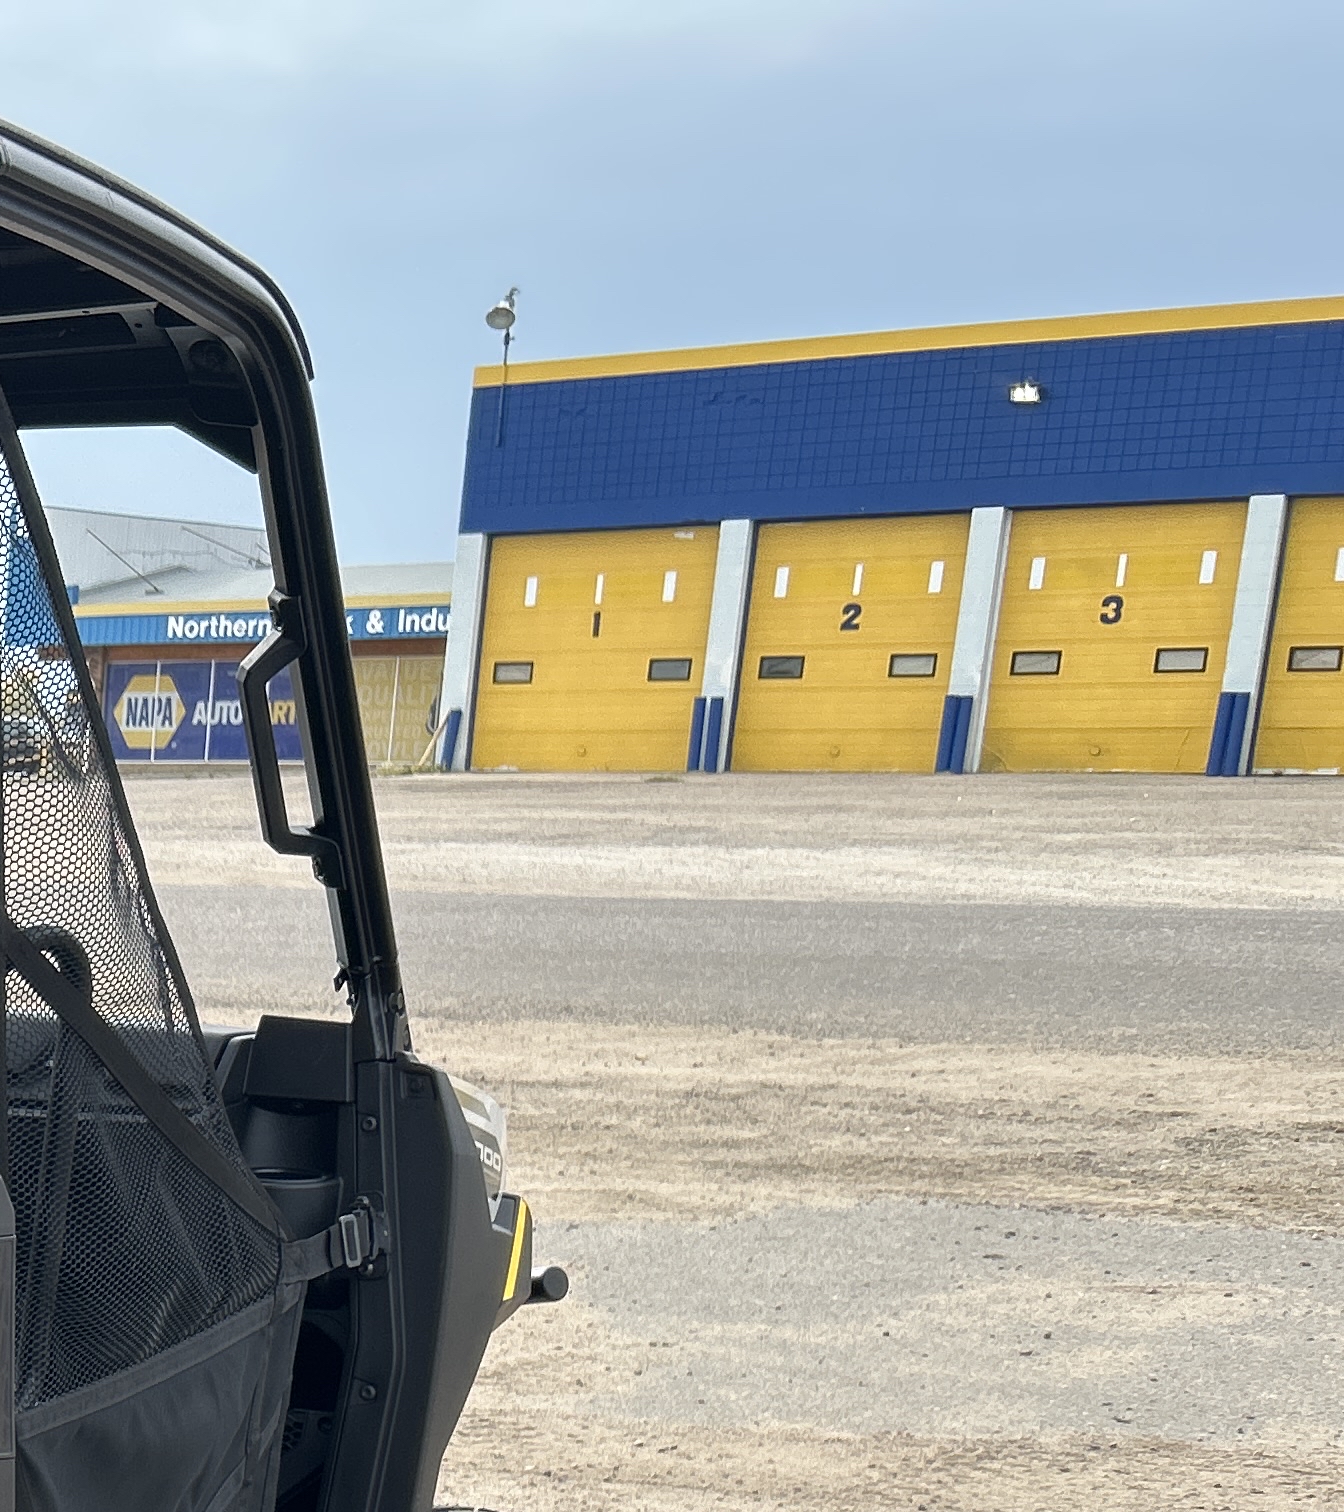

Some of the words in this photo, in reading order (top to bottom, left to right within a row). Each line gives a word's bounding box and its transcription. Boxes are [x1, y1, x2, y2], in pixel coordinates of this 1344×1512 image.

[167, 614, 272, 639] Northern
[365, 609, 385, 634] &
[398, 607, 450, 633] Indu
[591, 611, 601, 638] 1
[840, 603, 862, 632] 2
[1099, 595, 1125, 625] 3
[359, 684, 439, 705] QUALIT
[125, 696, 172, 728] NAPA
[192, 700, 243, 726] AUTO
